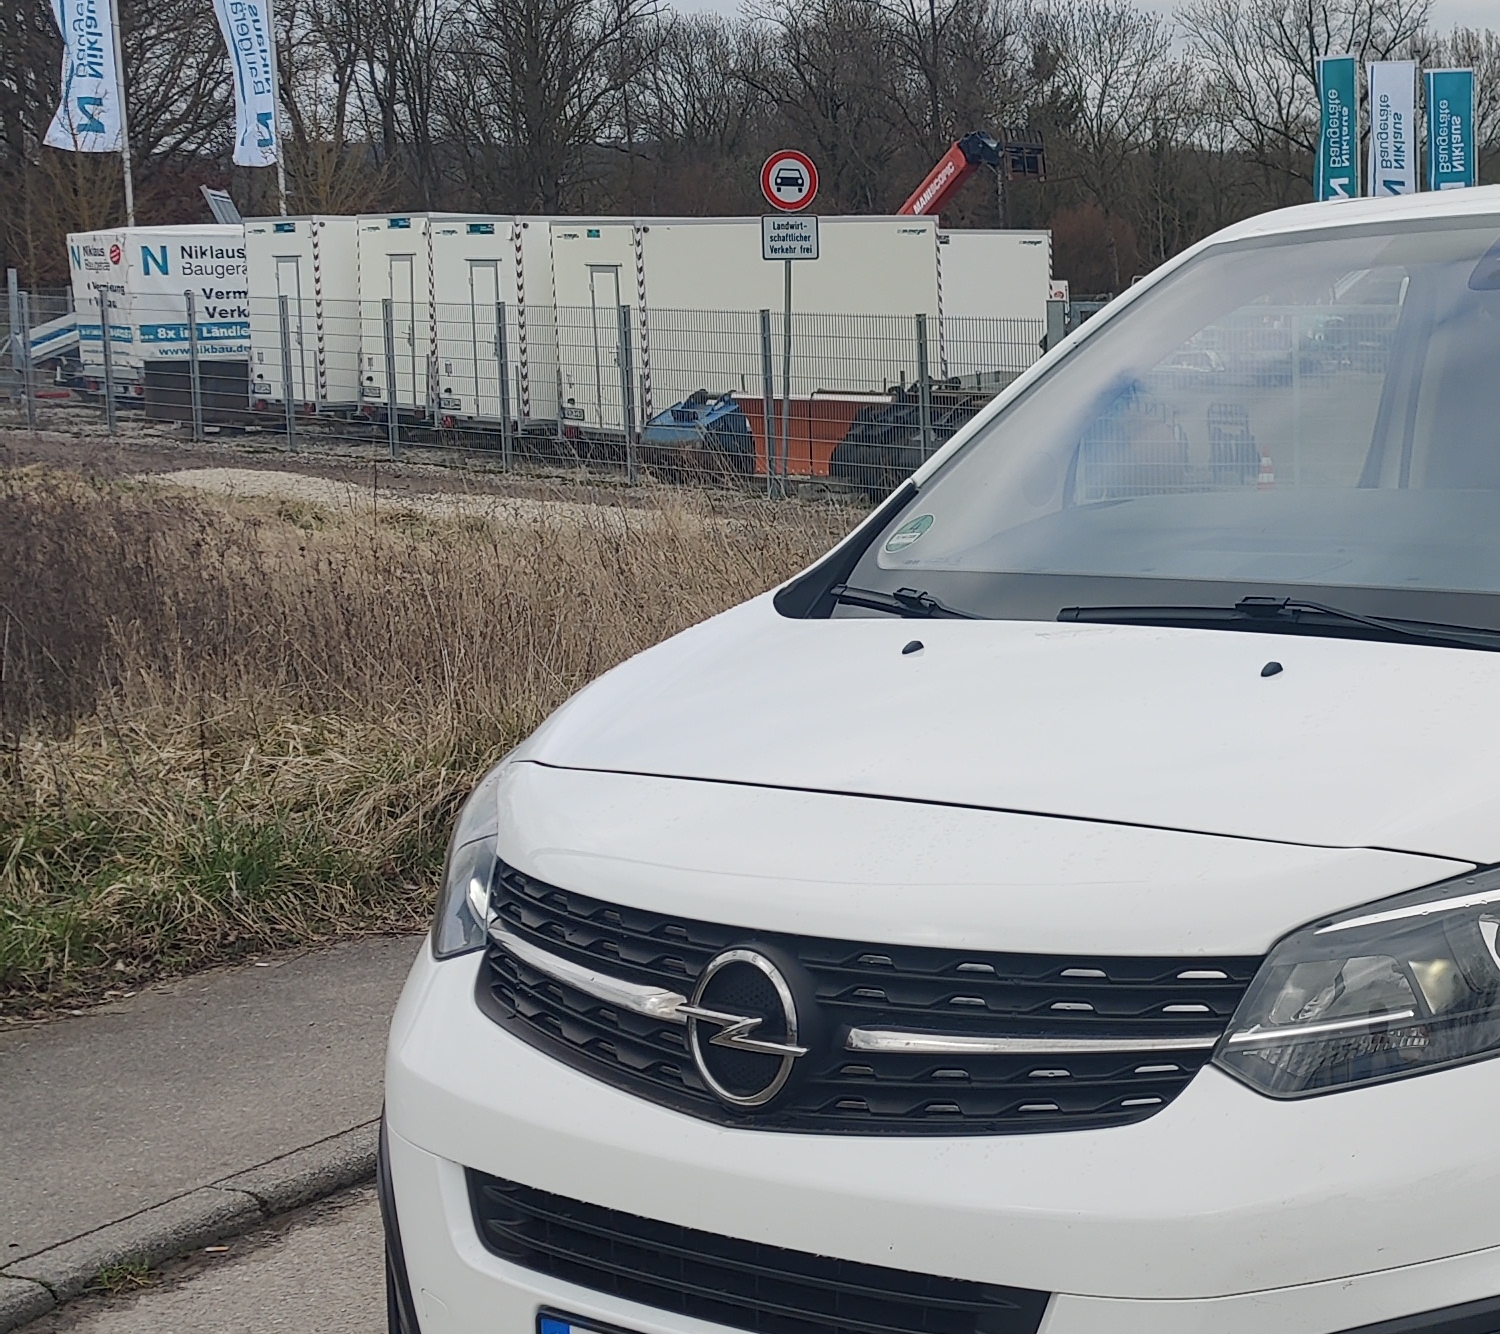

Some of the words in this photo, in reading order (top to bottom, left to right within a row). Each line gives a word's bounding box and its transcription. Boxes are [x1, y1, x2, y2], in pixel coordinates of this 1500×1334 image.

[772, 221, 808, 230] Landwirt-
[769, 233, 811, 242] schaftlicher
[181, 245, 246, 260] Niklaus
[769, 244, 796, 254] Verkehr
[800, 244, 812, 254] frei
[140, 245, 169, 276] N
[157, 327, 176, 339] 8x
